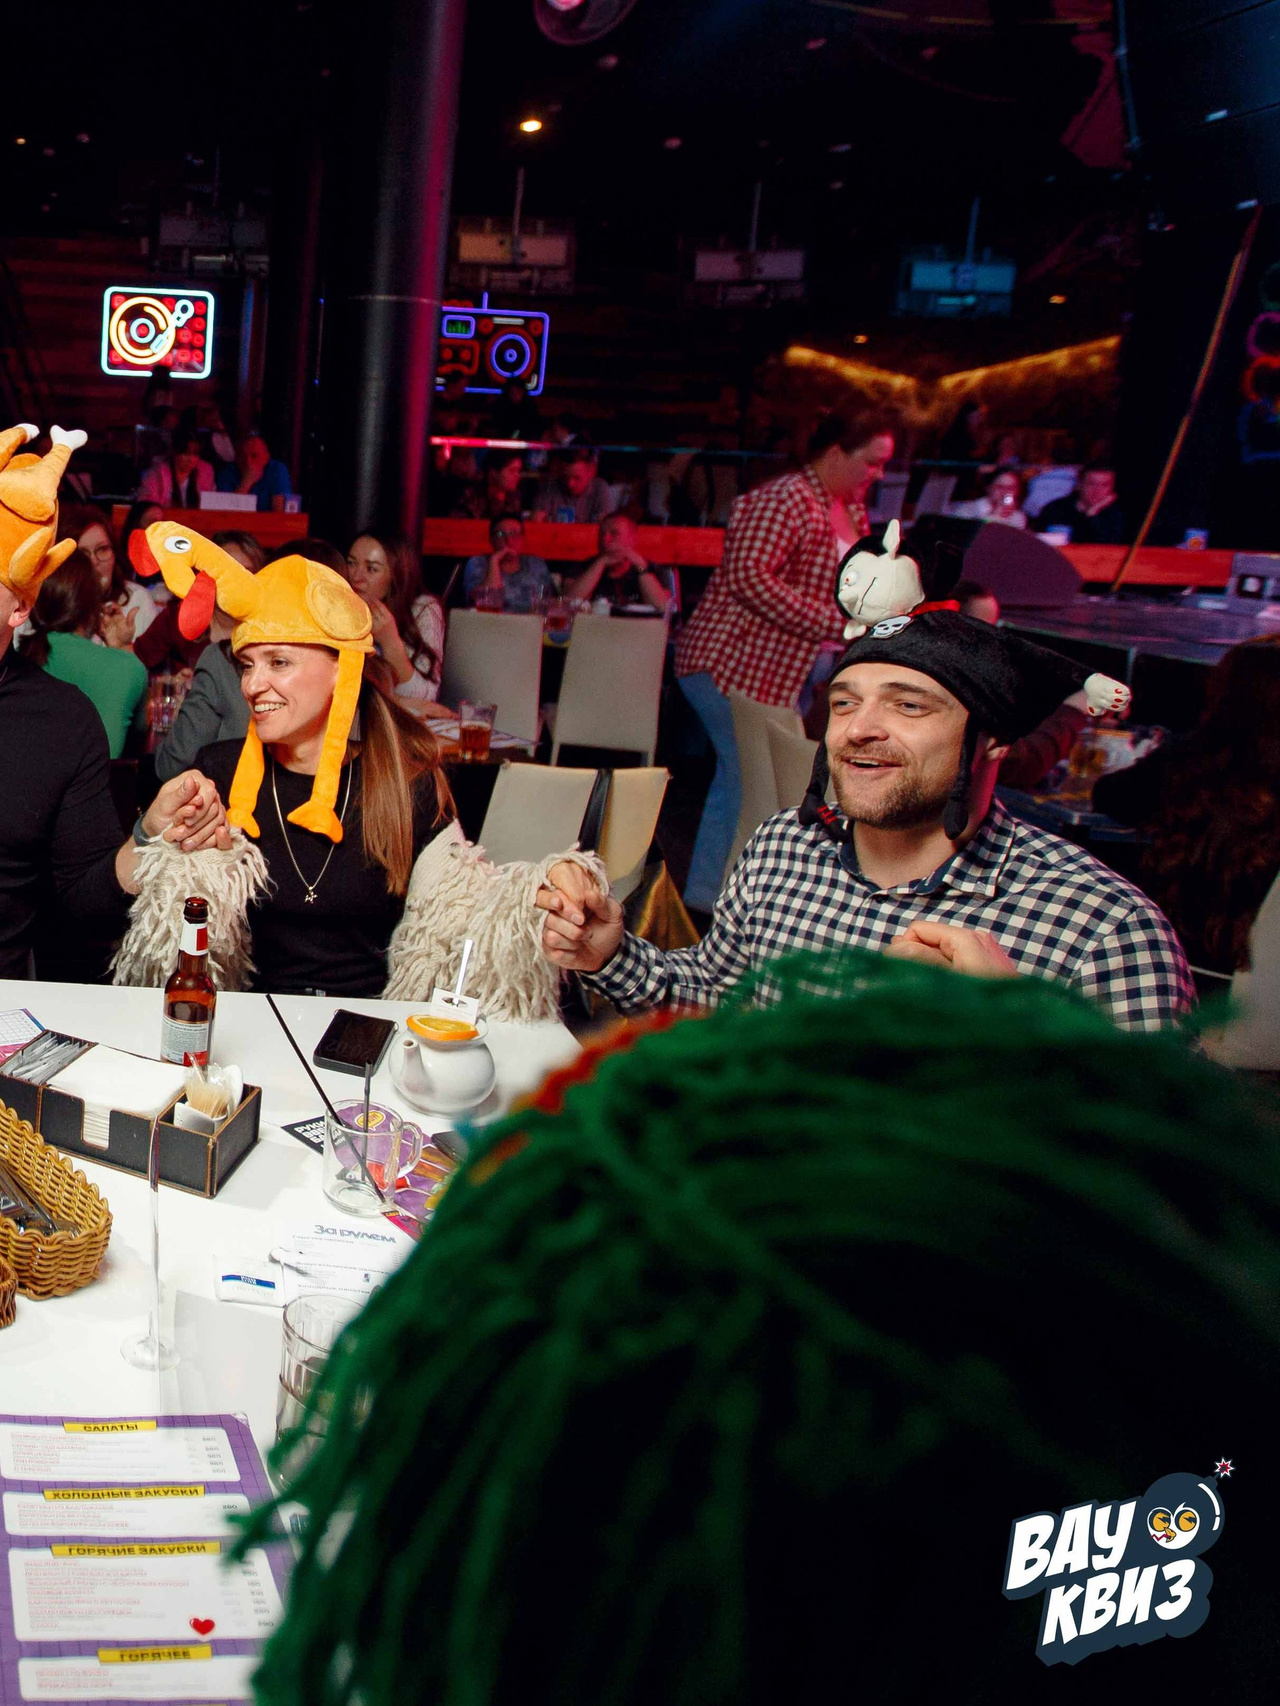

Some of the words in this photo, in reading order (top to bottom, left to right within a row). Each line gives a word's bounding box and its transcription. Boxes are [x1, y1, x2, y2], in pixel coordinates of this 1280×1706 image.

[83, 1424, 138, 1432] САЛАТЫ
[52, 1489, 132, 1499] ХОЛОДНЫЕ
[135, 1488, 199, 1498] ЗАКУСКИ
[68, 1547, 136, 1556] ГОРЯЧИЕ
[138, 1545, 206, 1555] ЗАКУСКИ
[120, 1650, 191, 1662] ГОРЯЧЕЕ
